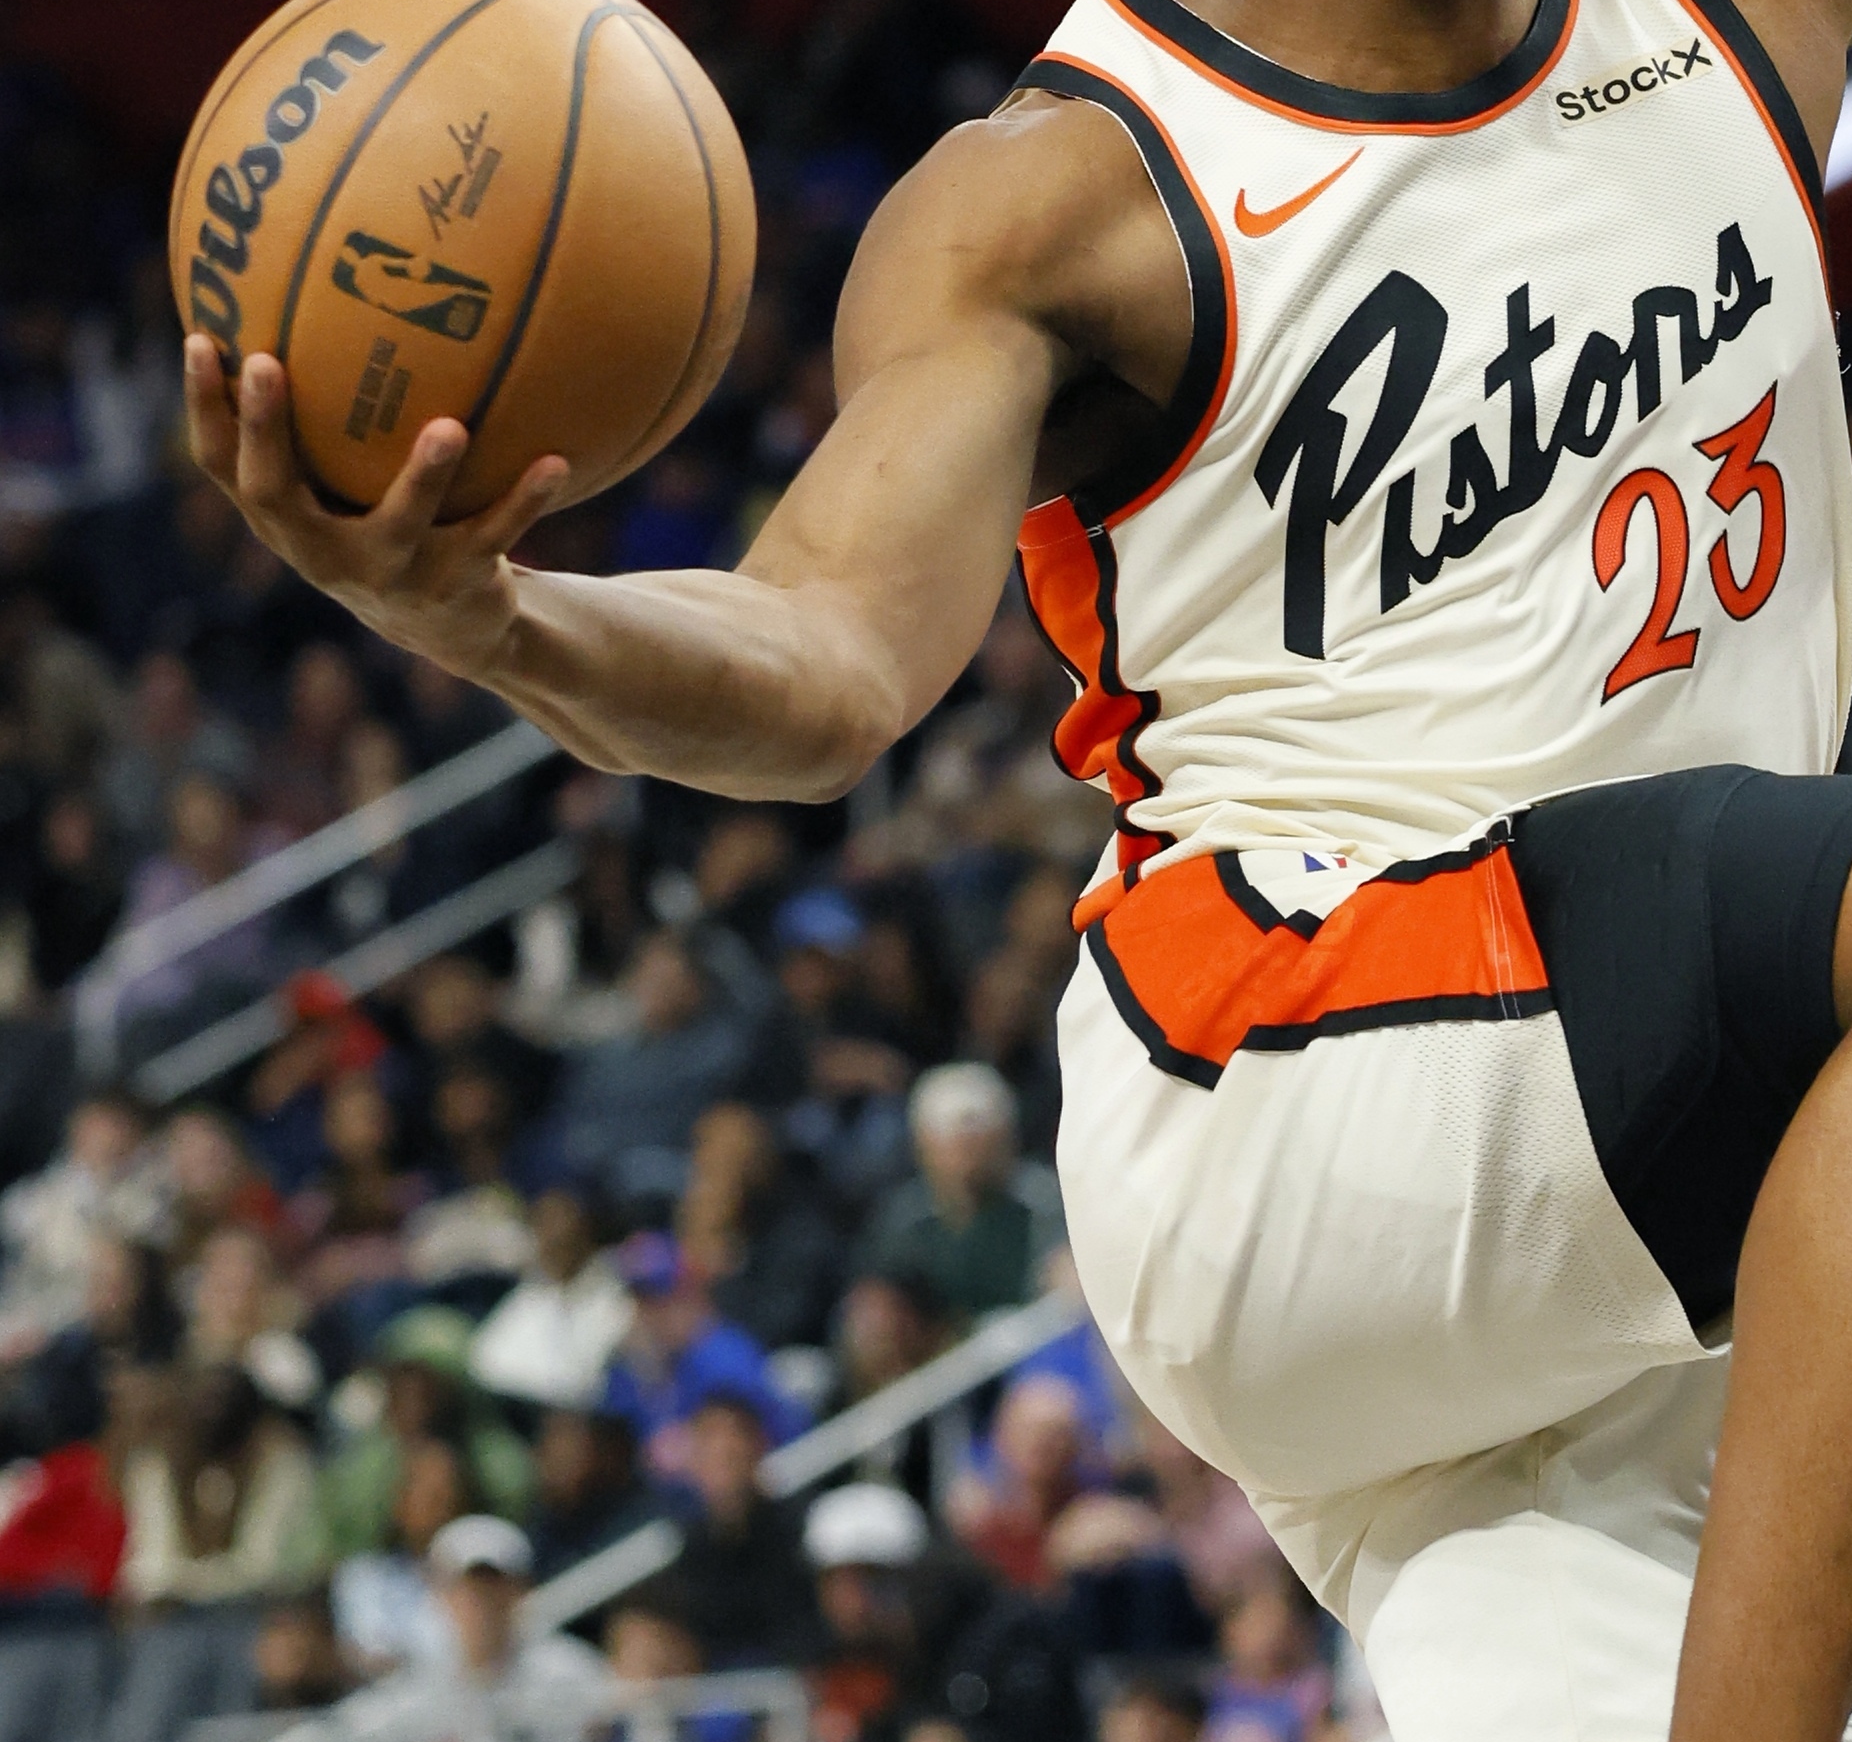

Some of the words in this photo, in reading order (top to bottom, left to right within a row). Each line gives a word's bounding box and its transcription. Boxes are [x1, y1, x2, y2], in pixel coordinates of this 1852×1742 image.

[1555, 37, 1714, 121] StockX
[1253, 221, 1774, 660] Pistons
[1591, 379, 1787, 707] 23
